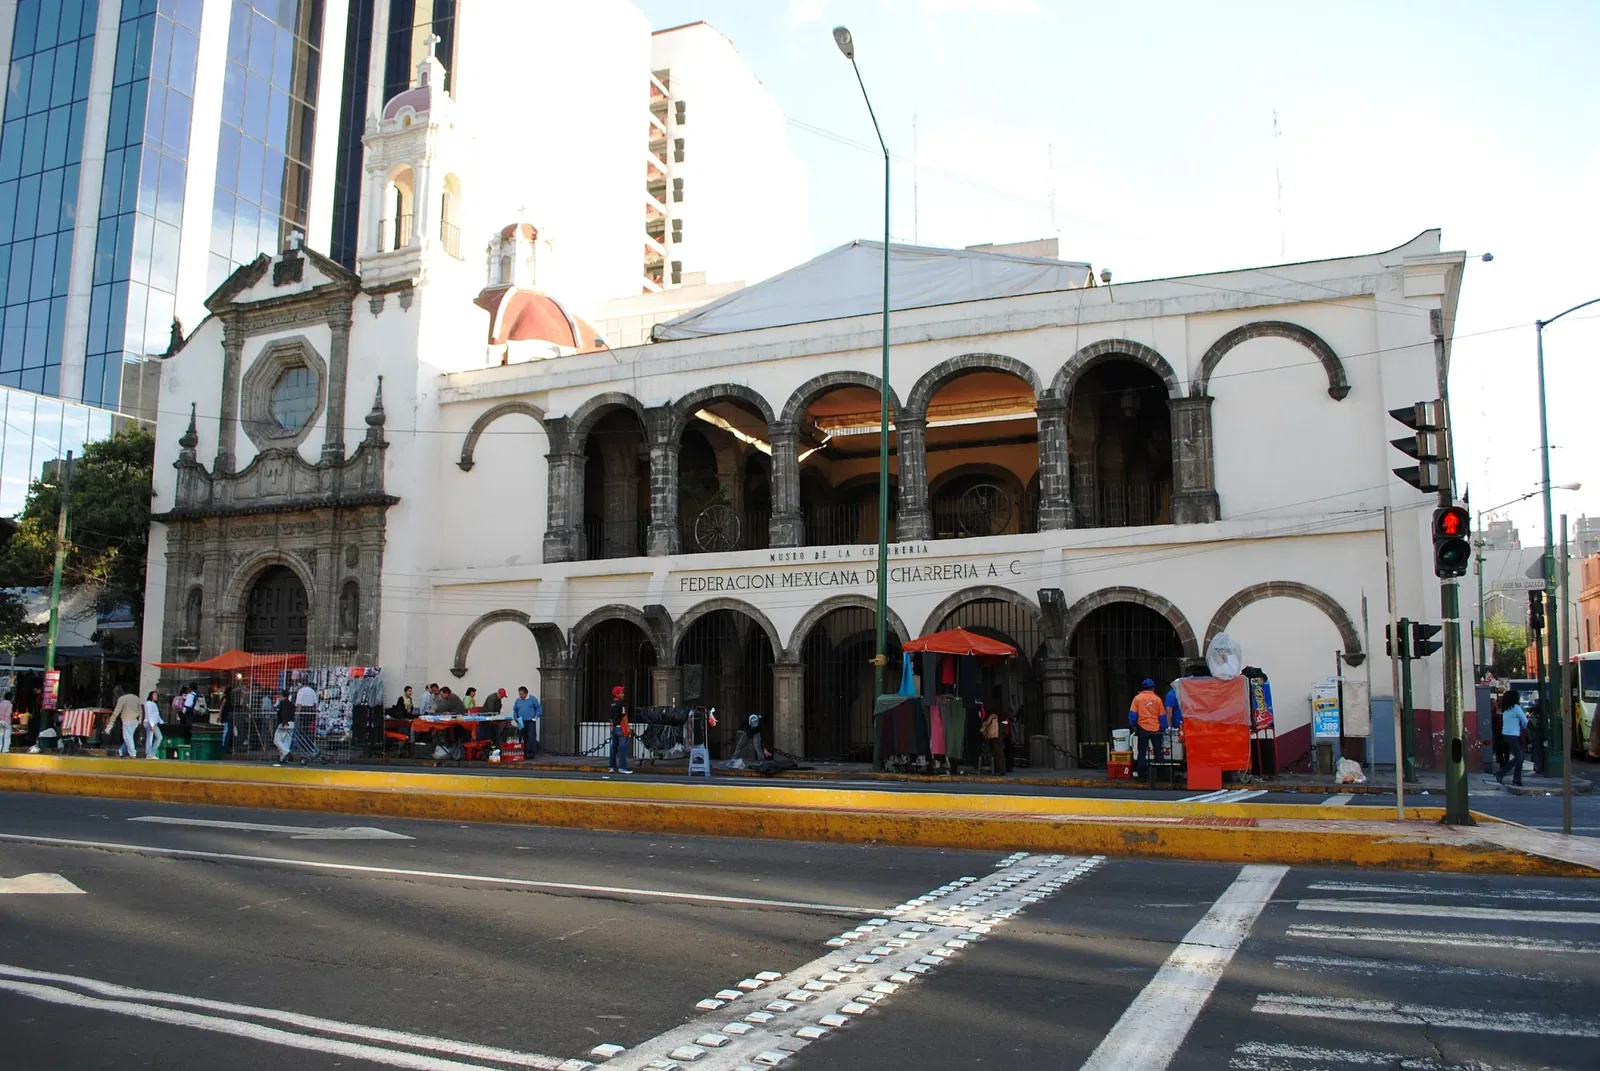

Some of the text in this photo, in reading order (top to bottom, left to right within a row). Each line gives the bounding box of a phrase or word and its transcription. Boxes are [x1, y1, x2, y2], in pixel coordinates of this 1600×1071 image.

[770, 545, 928, 562] MUSEO DE LA CHRRERIA
[680, 573, 775, 592] FEDERACION
[782, 570, 860, 588] MEXICANA
[890, 563, 979, 582] CHARRERIA
